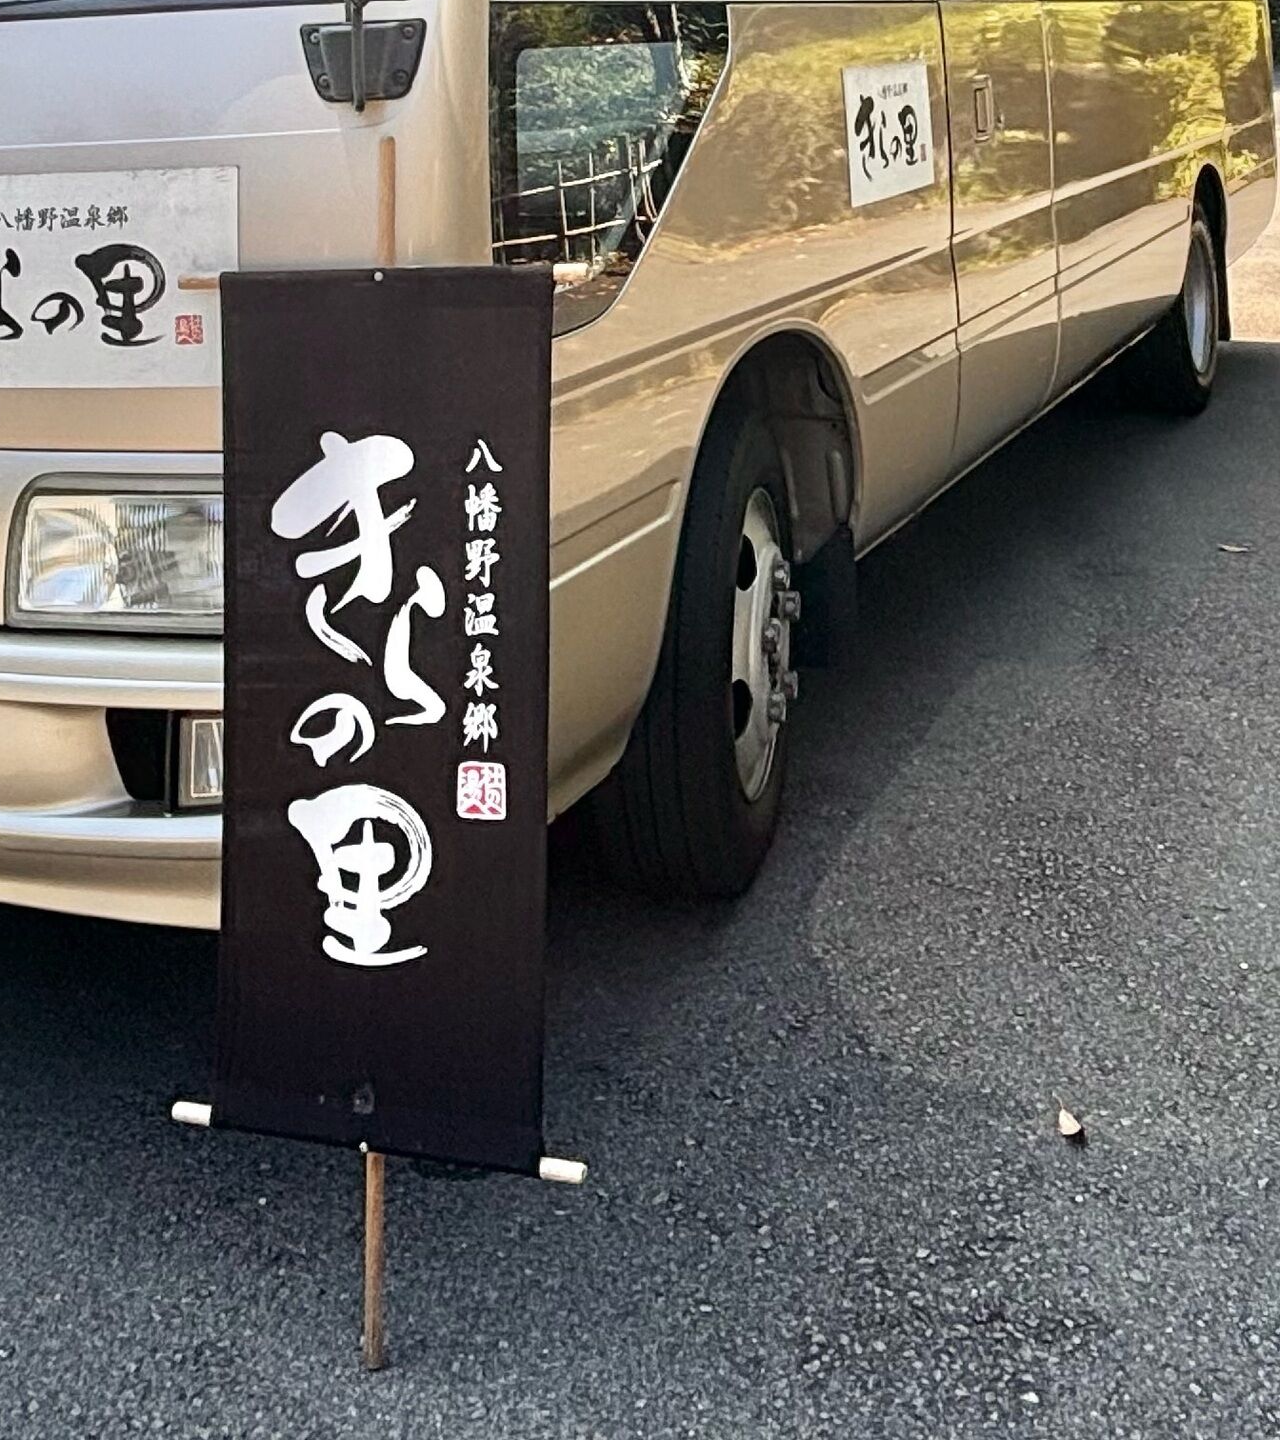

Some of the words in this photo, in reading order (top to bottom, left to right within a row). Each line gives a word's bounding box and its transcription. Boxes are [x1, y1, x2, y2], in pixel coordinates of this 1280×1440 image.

[854, 94, 918, 182] きらの里
[271, 431, 446, 967] きらの里
[463, 438, 503, 754] 八幡野温泉郷
